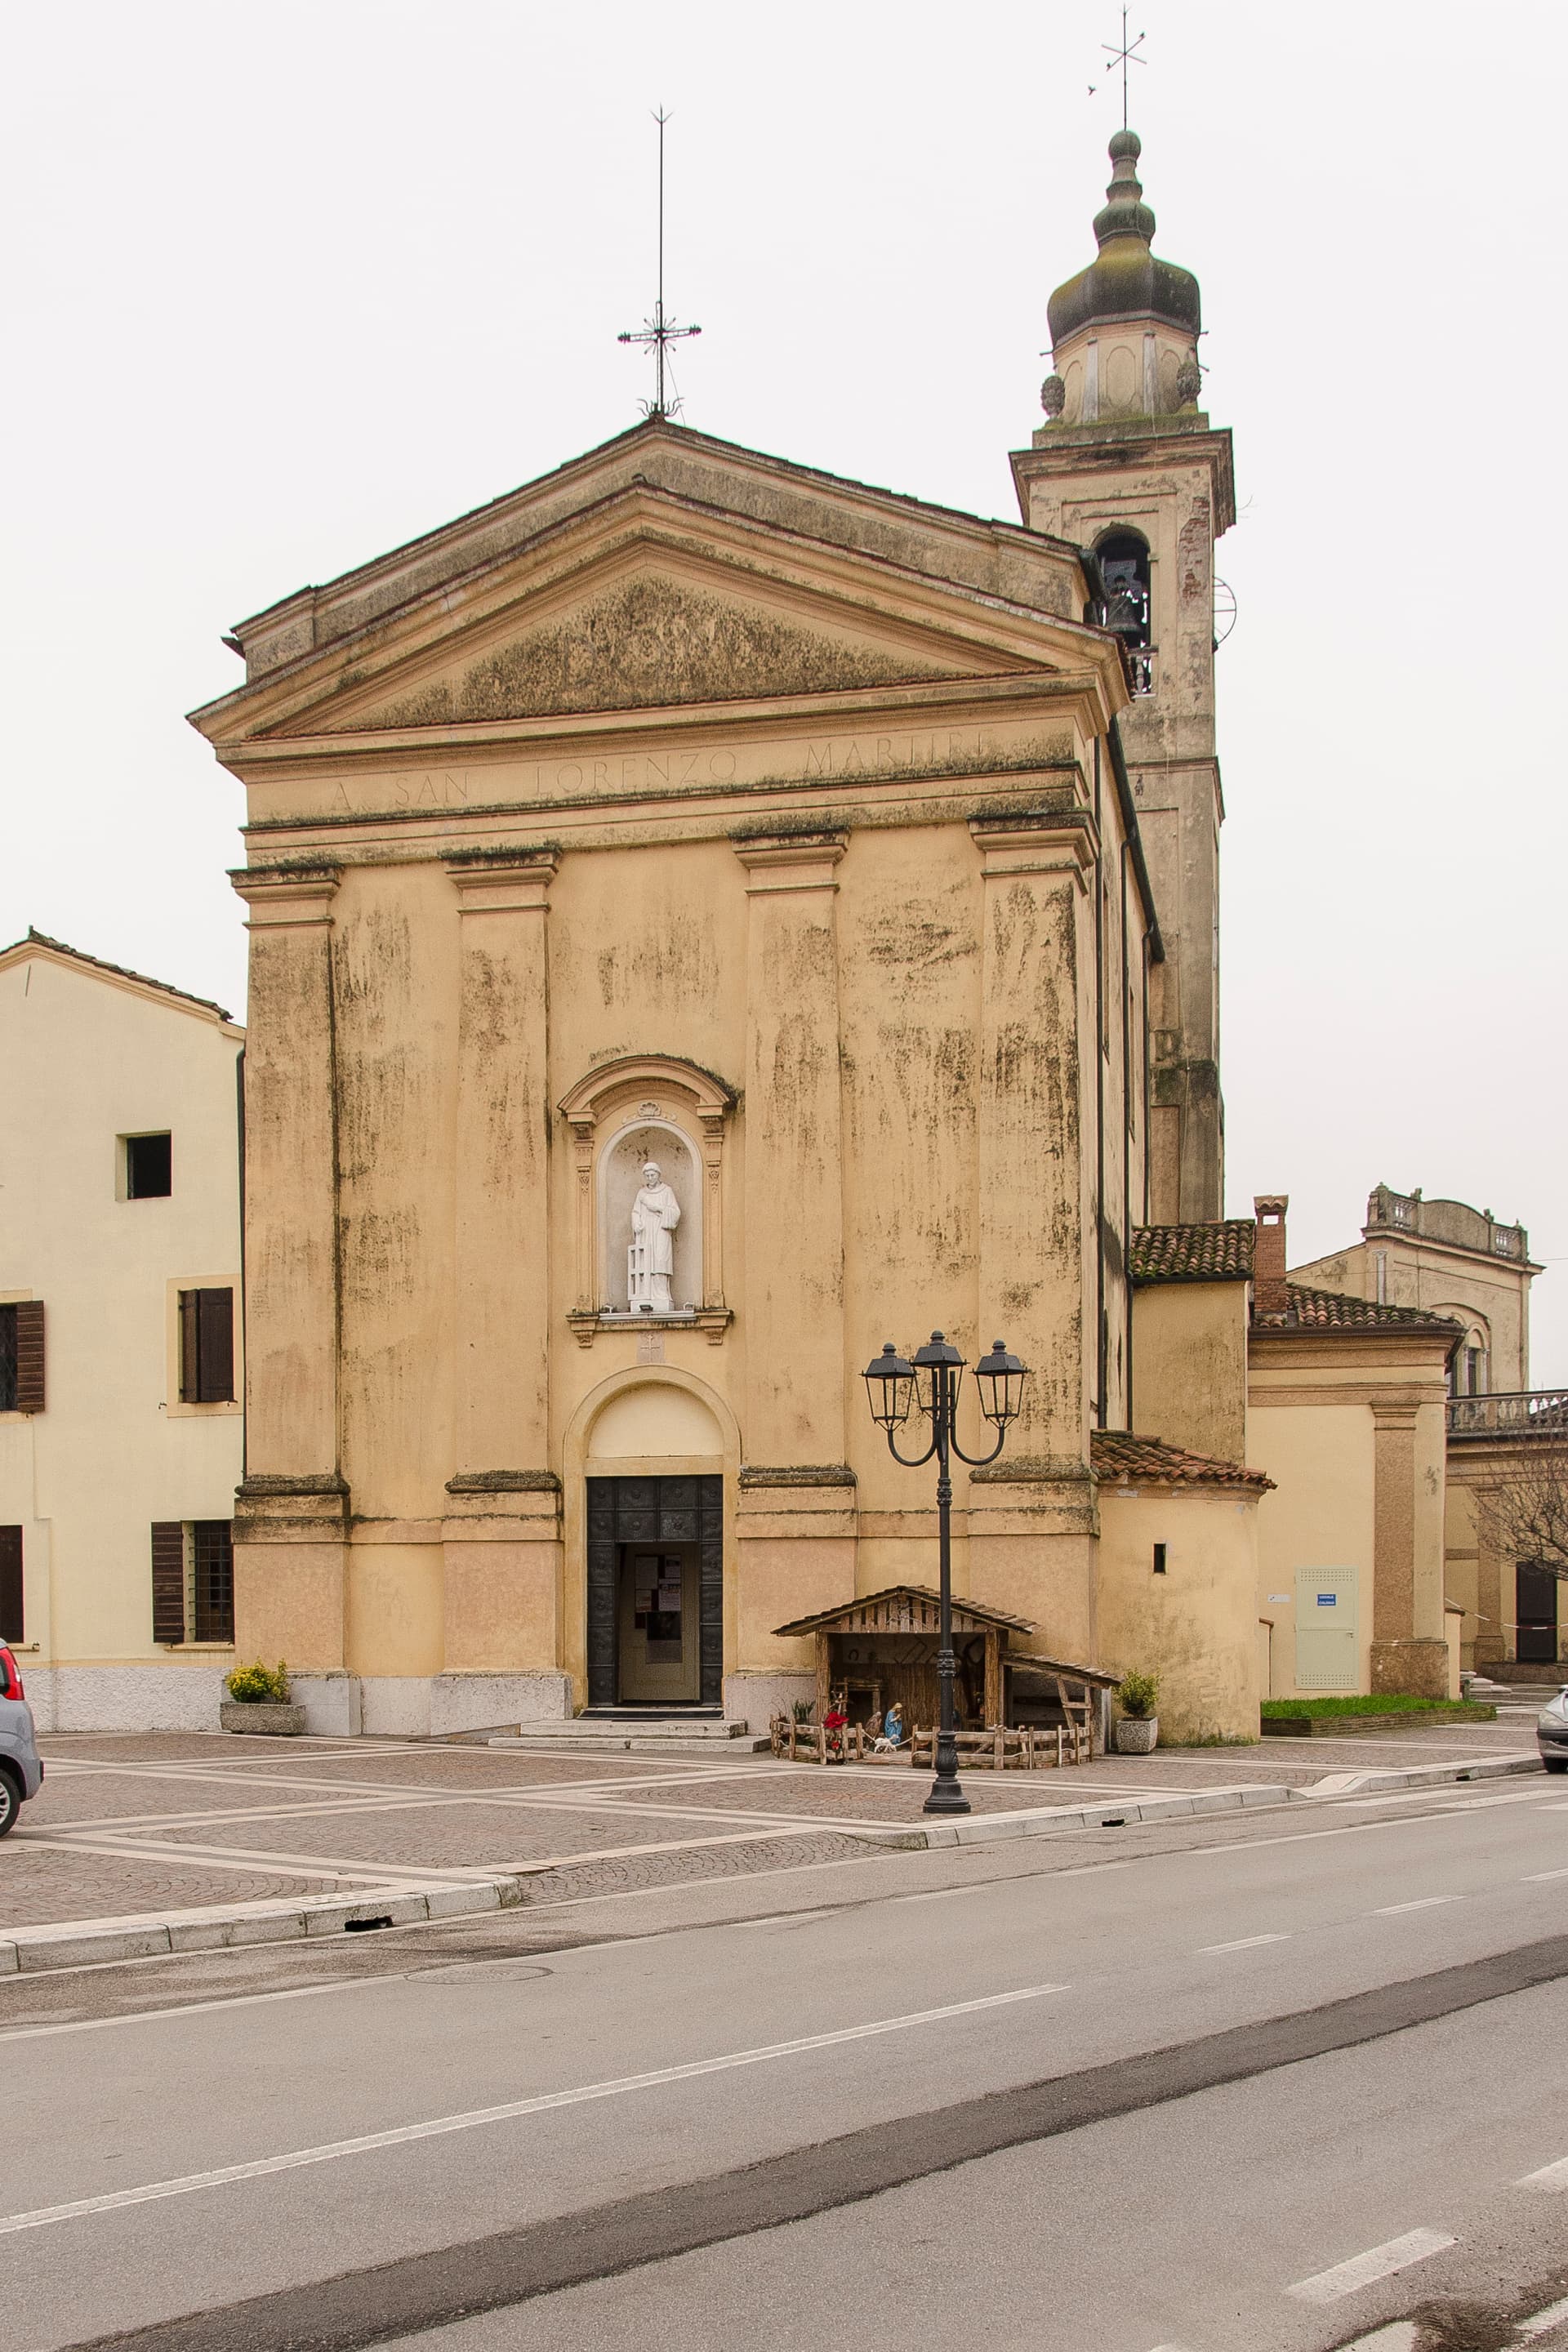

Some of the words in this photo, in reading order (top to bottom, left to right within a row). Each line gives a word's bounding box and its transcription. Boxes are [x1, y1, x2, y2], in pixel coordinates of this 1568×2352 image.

[330, 782, 353, 811] A
[394, 773, 469, 808] SAN
[536, 750, 737, 797] LORENZO
[804, 728, 994, 775] MARTIRE
